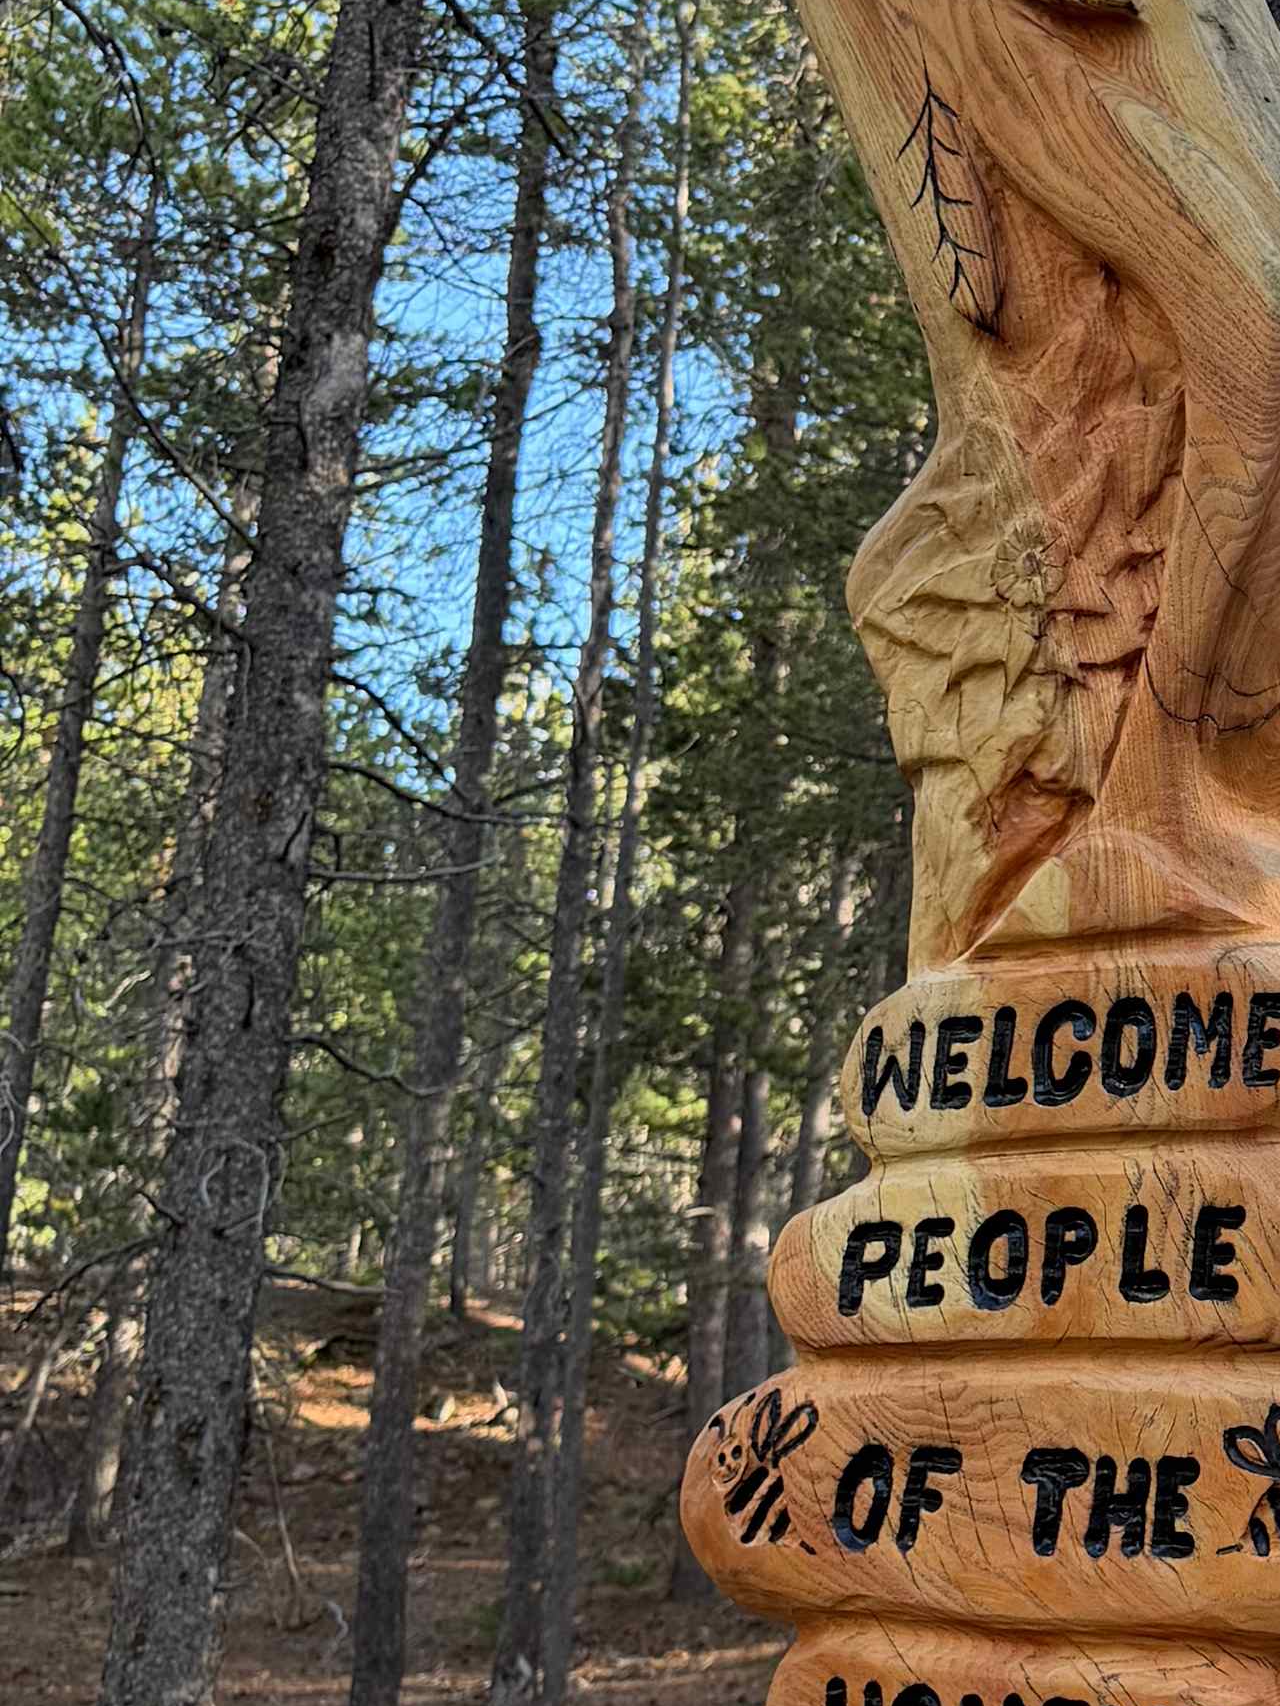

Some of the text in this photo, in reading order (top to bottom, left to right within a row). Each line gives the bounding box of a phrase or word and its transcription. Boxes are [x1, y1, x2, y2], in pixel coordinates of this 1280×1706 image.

[836, 1204, 1247, 1317] PEOPLE
[832, 1443, 1201, 1561] OF THE
